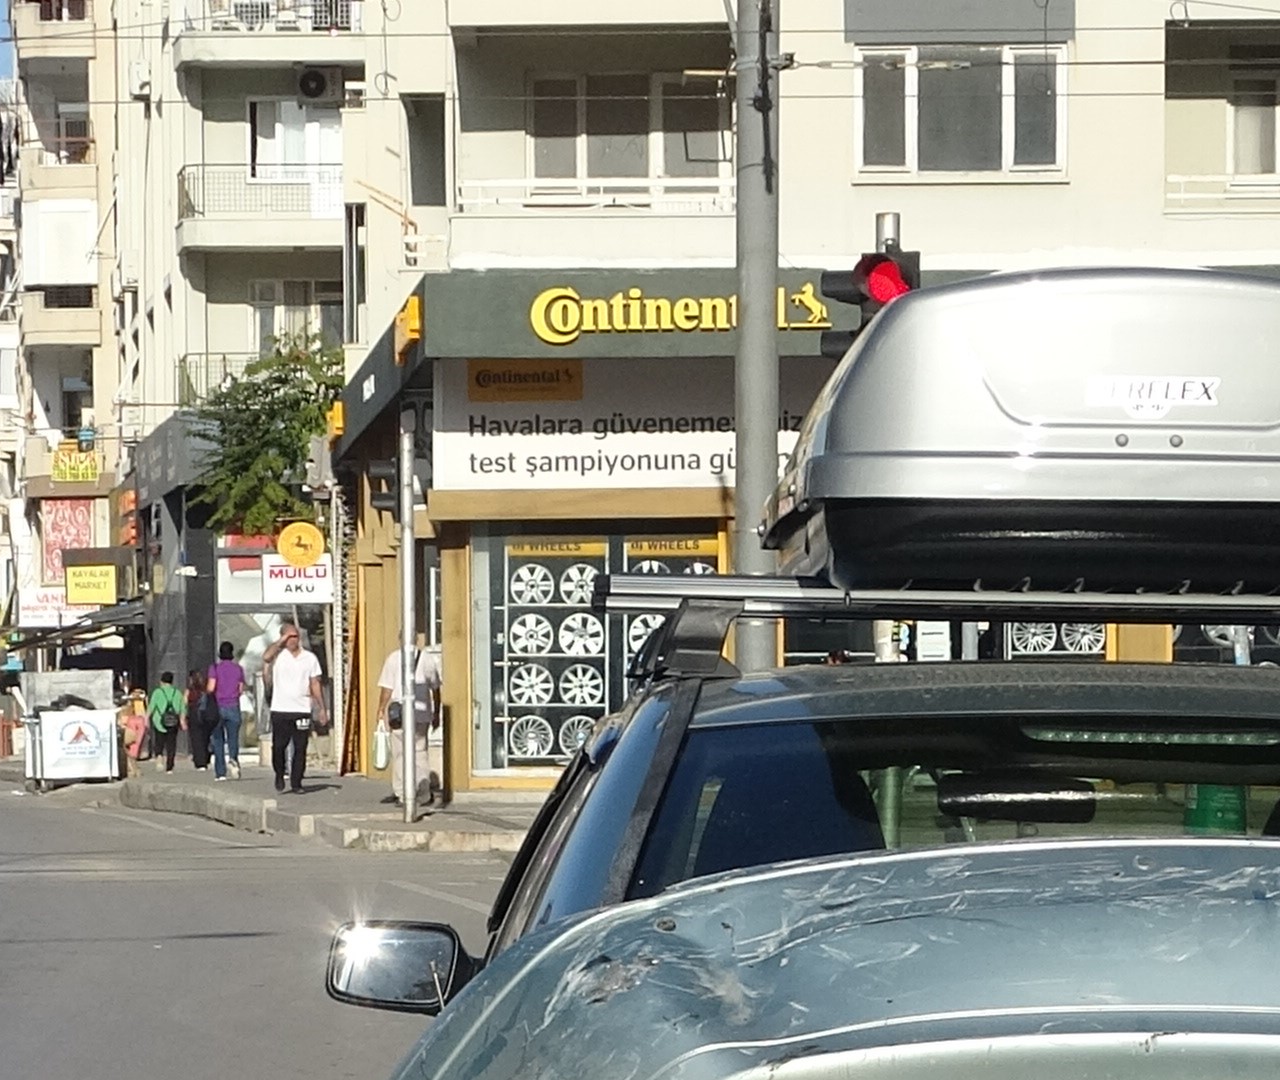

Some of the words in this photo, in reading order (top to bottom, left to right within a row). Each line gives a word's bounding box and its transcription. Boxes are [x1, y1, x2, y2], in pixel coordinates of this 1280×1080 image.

[530, 286, 789, 345] Continentl
[475, 368, 560, 388] Continental
[469, 413, 583, 438] Havalara
[470, 450, 516, 474] test
[526, 449, 701, 477] şampiyonuna
[648, 538, 700, 551] WHEELS
[74, 581, 107, 589] MARKET
